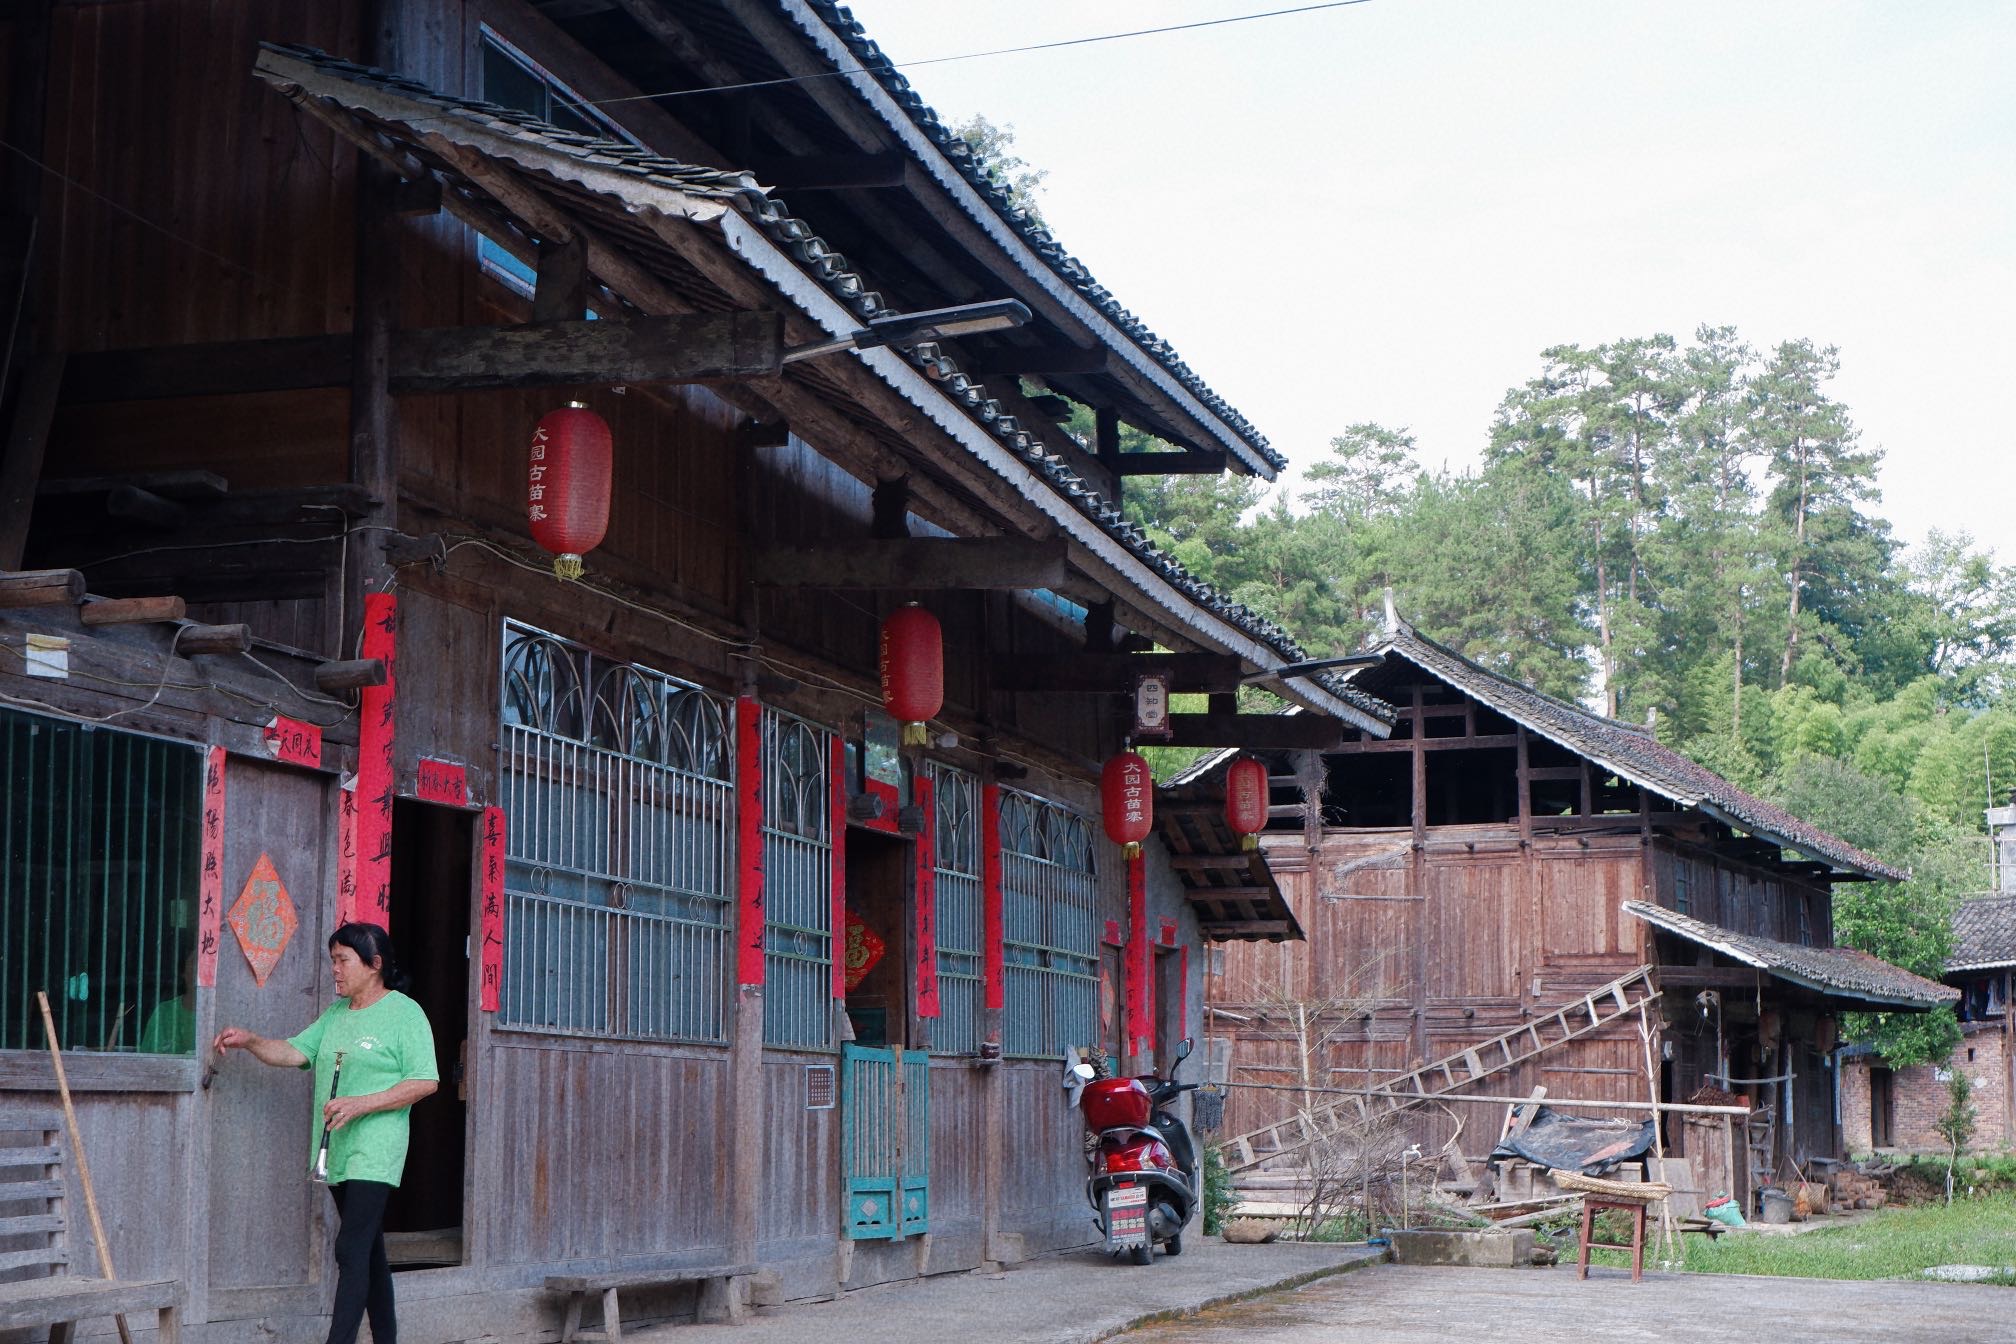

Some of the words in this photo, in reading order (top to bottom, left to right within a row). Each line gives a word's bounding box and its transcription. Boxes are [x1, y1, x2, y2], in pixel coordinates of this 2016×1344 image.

[529, 427, 549, 521] 大园古苗寨
[420, 768, 463, 800] 新春大吉
[1123, 762, 1143, 822] 大园古苗寨
[248, 878, 284, 949] 福
